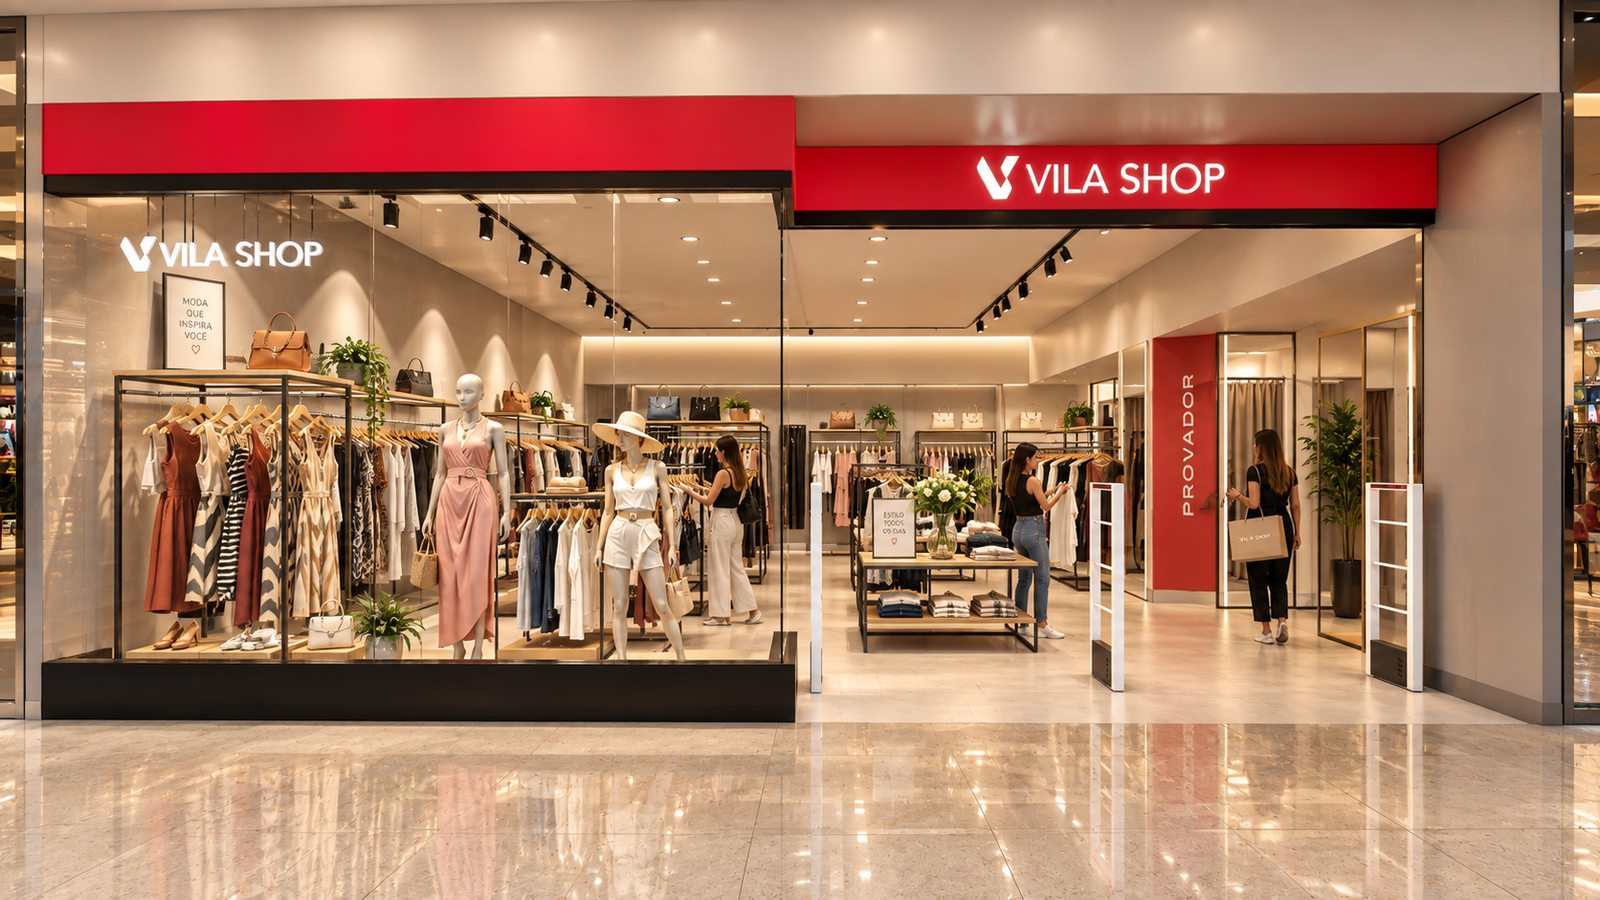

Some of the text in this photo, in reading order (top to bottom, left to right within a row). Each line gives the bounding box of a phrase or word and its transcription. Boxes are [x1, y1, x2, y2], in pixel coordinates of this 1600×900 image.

[1025, 163, 1109, 194] VILA
[1119, 162, 1225, 194] SHOP
[159, 242, 229, 268] VILA
[235, 241, 324, 268] SHOP
[182, 297, 209, 307] MODA
[186, 309, 204, 318] QUE
[179, 320, 213, 330] INSPIRA
[184, 331, 207, 341] VOCÊ
[1182, 374, 1194, 516] PROVADOR
[883, 511, 905, 519] ESTILO
[1238, 535, 1254, 543] VILA
